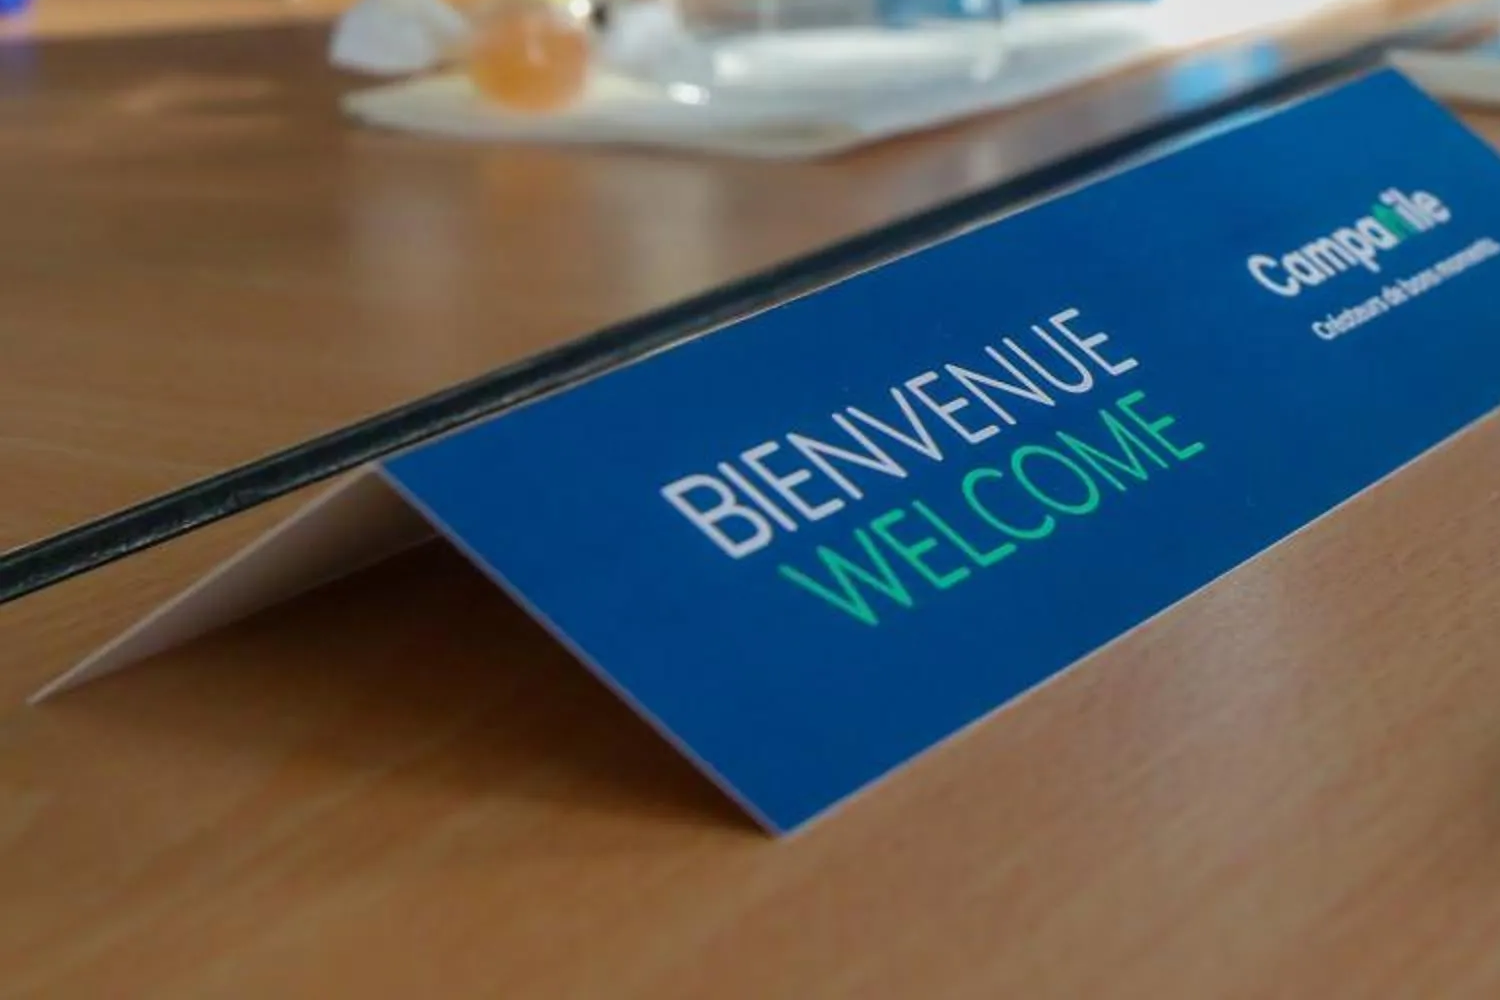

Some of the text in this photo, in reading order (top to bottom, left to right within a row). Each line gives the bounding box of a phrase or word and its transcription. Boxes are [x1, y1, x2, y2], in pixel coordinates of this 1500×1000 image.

[1247, 186, 1451, 297] Campanile
[661, 307, 1139, 559] BIENVENUE
[779, 390, 1206, 627] WELCOME
